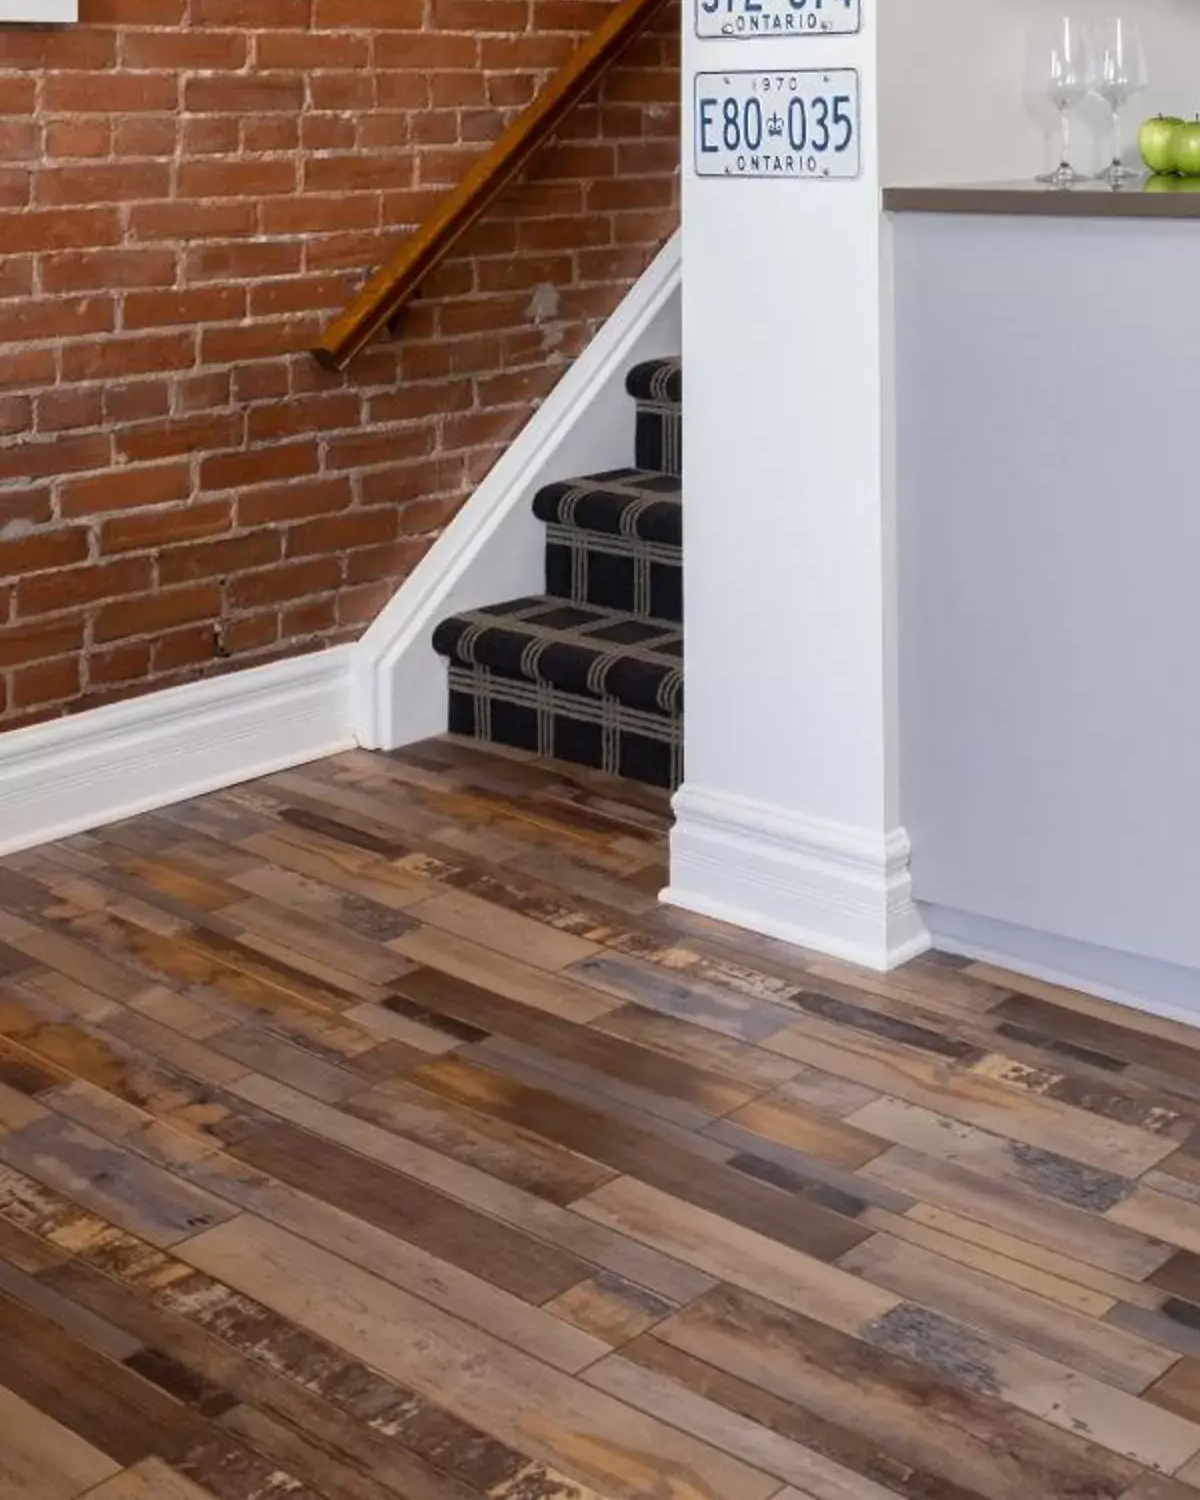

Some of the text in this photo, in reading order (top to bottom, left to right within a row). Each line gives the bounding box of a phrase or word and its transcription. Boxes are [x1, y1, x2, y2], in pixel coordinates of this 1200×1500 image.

[736, 13, 817, 33] ONTARIO
[700, 99, 761, 153] E80
[736, 155, 817, 174] ONTARIO
